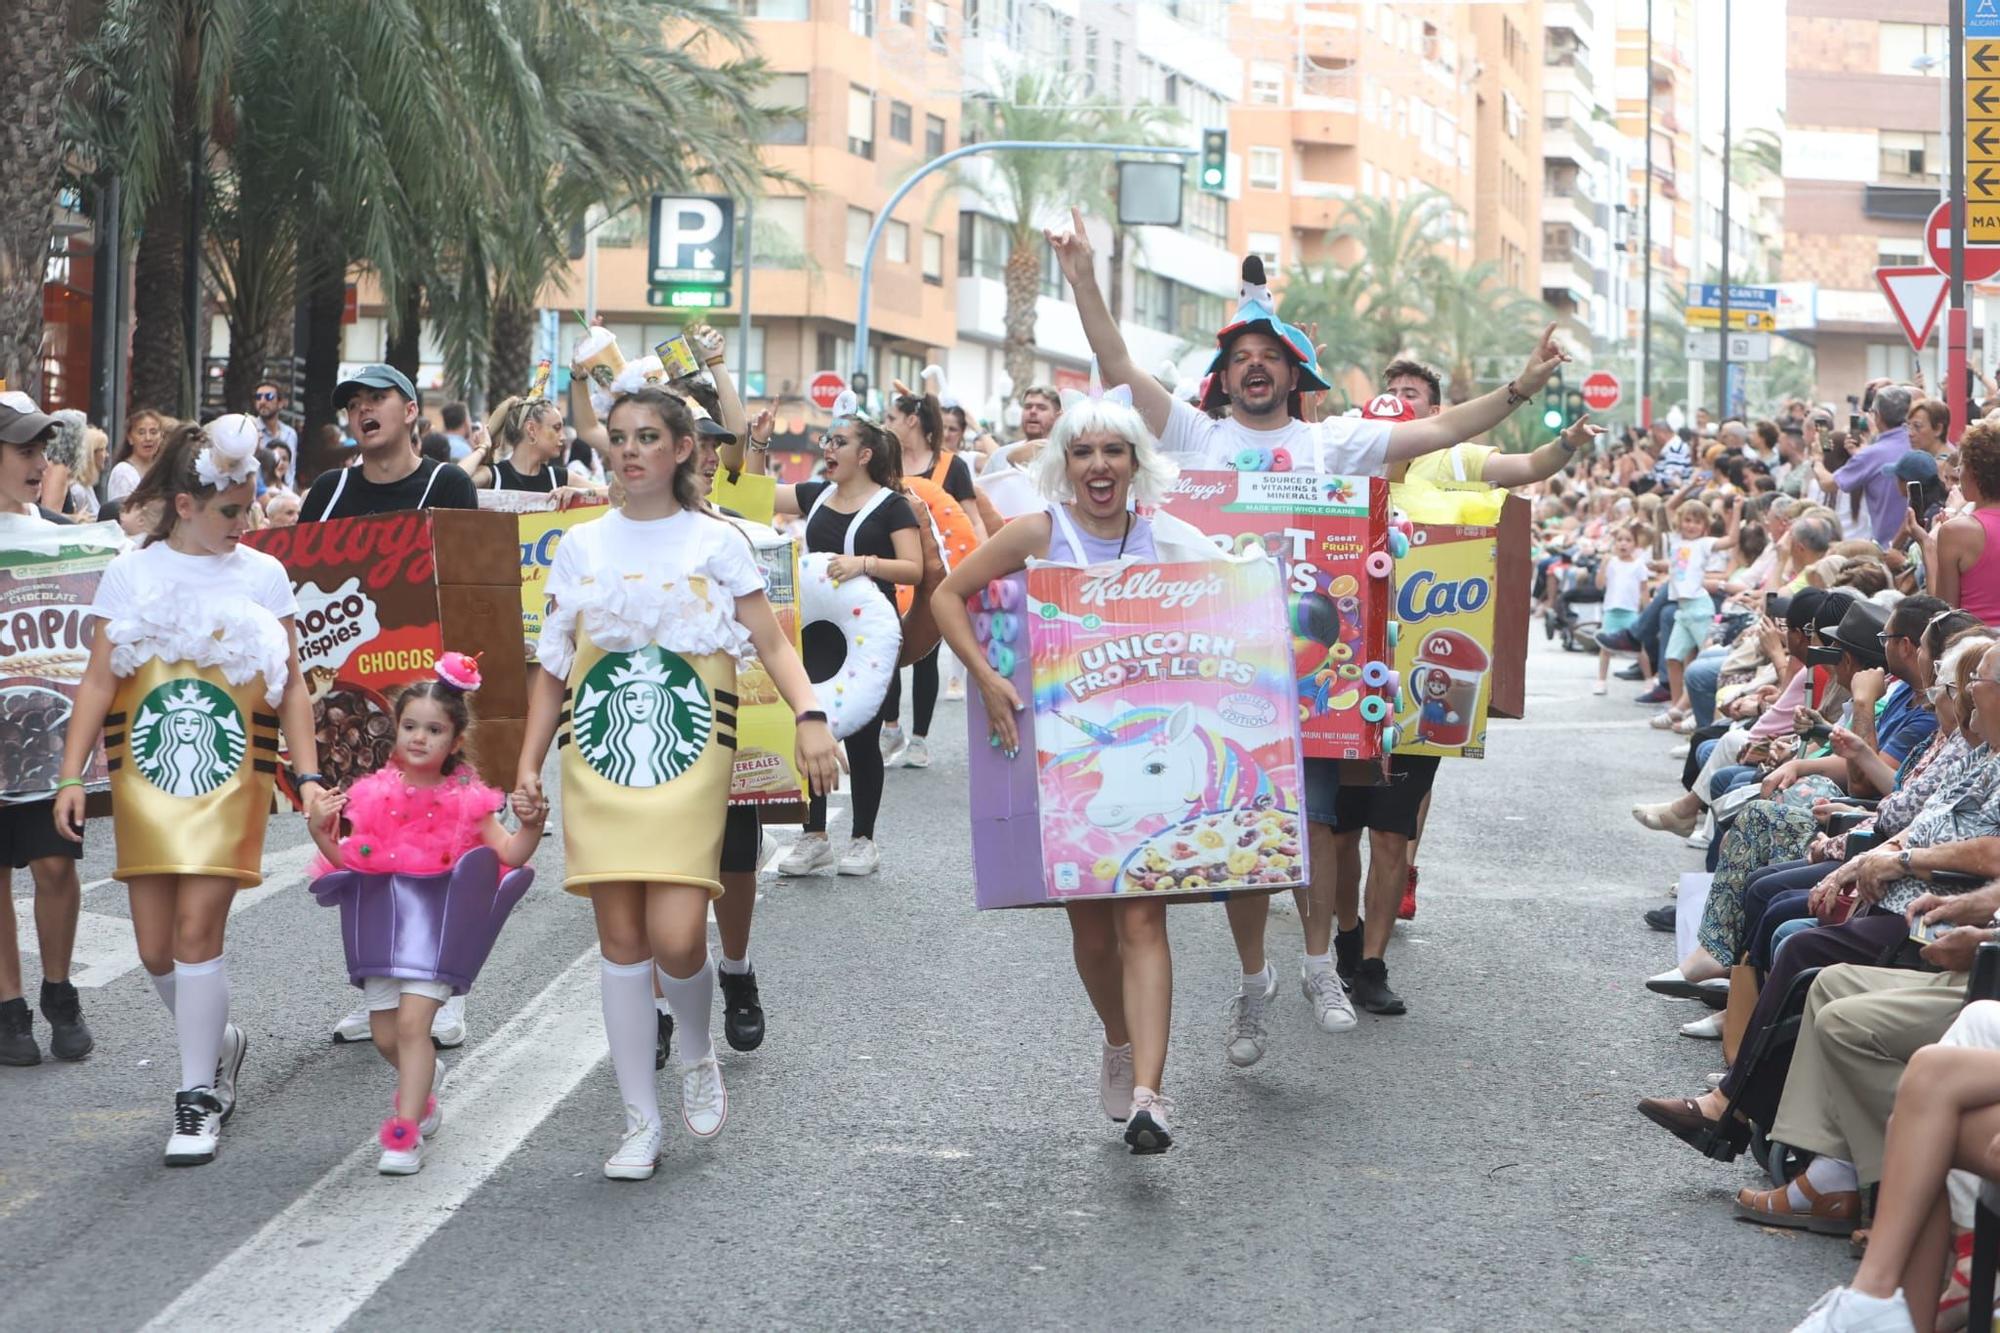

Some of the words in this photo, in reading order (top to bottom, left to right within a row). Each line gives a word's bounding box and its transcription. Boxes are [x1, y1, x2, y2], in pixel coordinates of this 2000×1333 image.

[659, 198, 723, 268] P
[1713, 288, 1765, 299] ACANTE
[1583, 386, 1617, 397] STOP
[1263, 476, 1303, 484] SOURCE
[1305, 477, 1318, 485] OF
[1261, 484, 1308, 492] VITAMINS
[1267, 492, 1318, 501] MINERALS
[1325, 507, 1355, 515] GRAINS
[1080, 569, 1226, 609] Kellogg's
[9, 592, 78, 604] CHOCOLATE
[299, 621, 361, 663] rispies
[1082, 631, 1236, 670] UNICORN
[358, 648, 435, 674] CHOCOS
[1070, 658, 1163, 698] FROOT
[1170, 658, 1255, 684] LOOPS
[733, 757, 780, 773] EREALES
